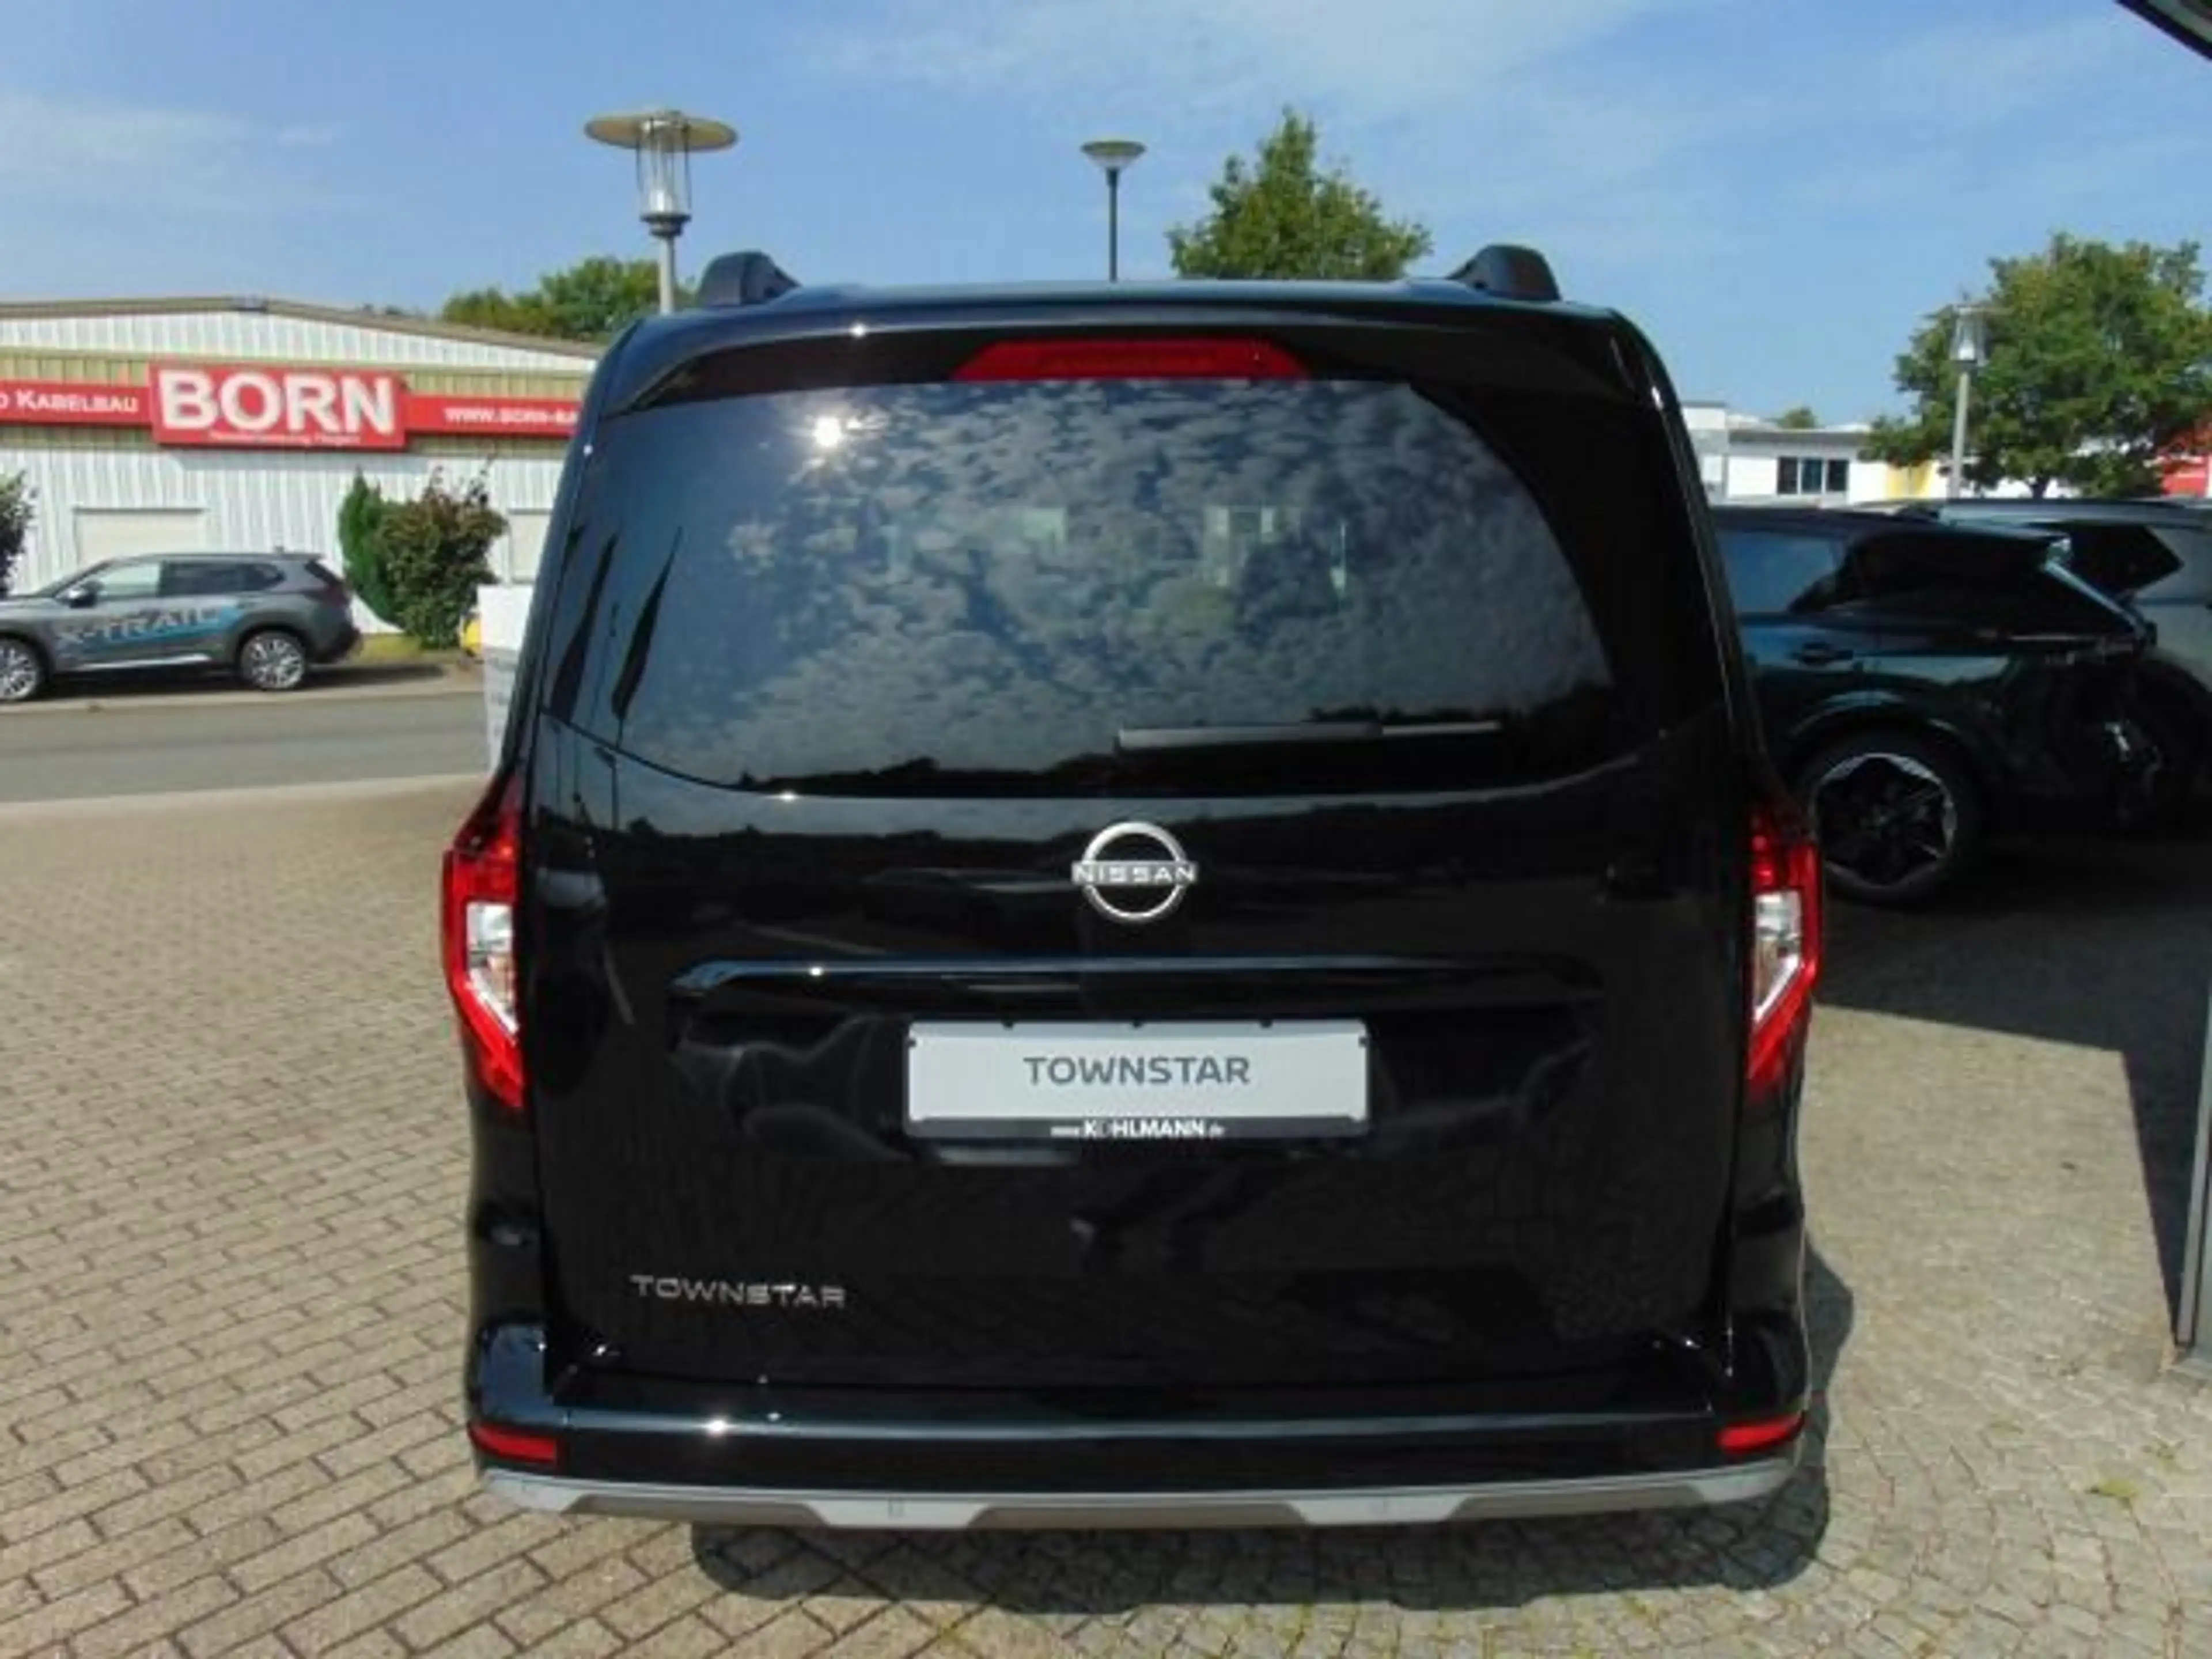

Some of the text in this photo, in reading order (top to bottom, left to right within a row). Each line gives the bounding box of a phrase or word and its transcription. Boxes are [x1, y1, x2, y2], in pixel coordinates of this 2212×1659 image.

[158, 369, 393, 434] BORN
[1071, 861, 1198, 885] NISSAN
[1024, 1056, 1251, 1085] TOWNSTAR
[630, 1275, 846, 1308] TOWNSTAR
